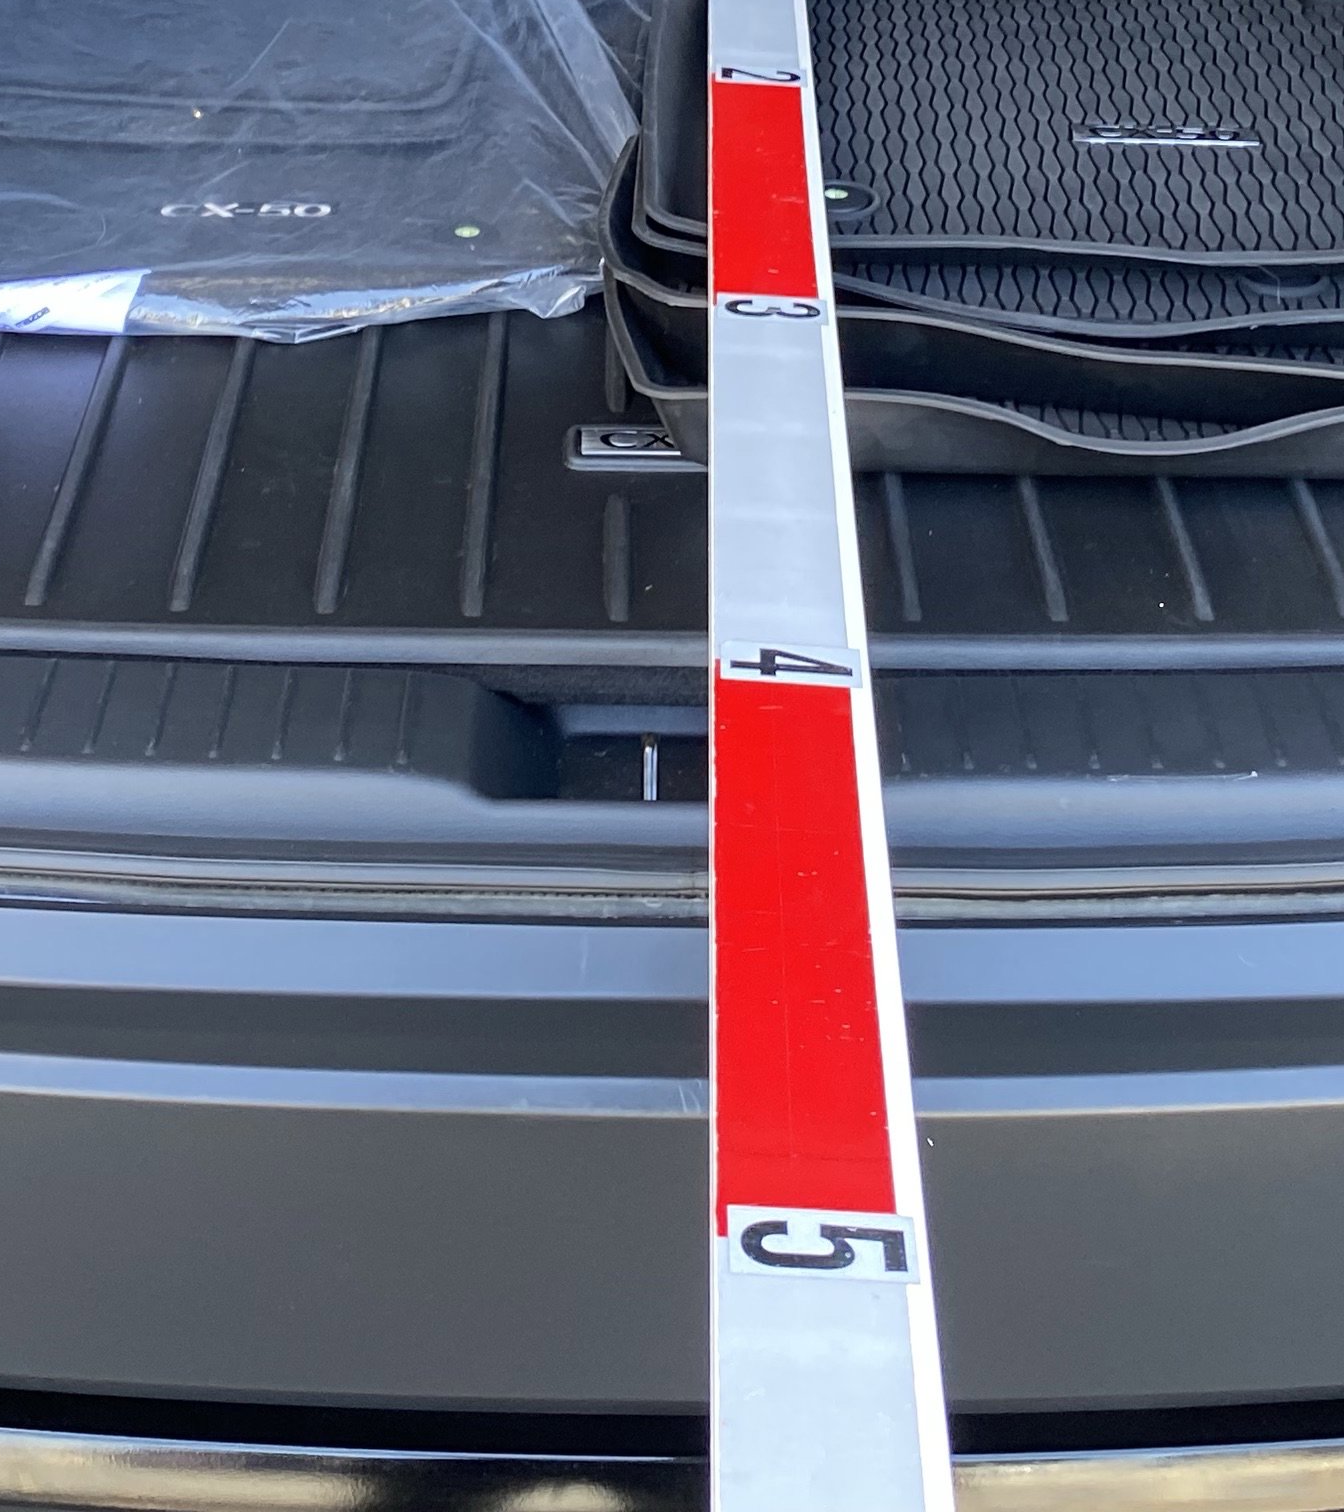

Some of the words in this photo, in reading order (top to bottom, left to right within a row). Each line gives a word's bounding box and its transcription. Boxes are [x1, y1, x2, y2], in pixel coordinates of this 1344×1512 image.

[721, 67, 801, 82] 2
[159, 202, 332, 218] CX-50
[724, 299, 821, 318] 3
[730, 648, 853, 677] 4
[740, 1220, 908, 1272] 5
